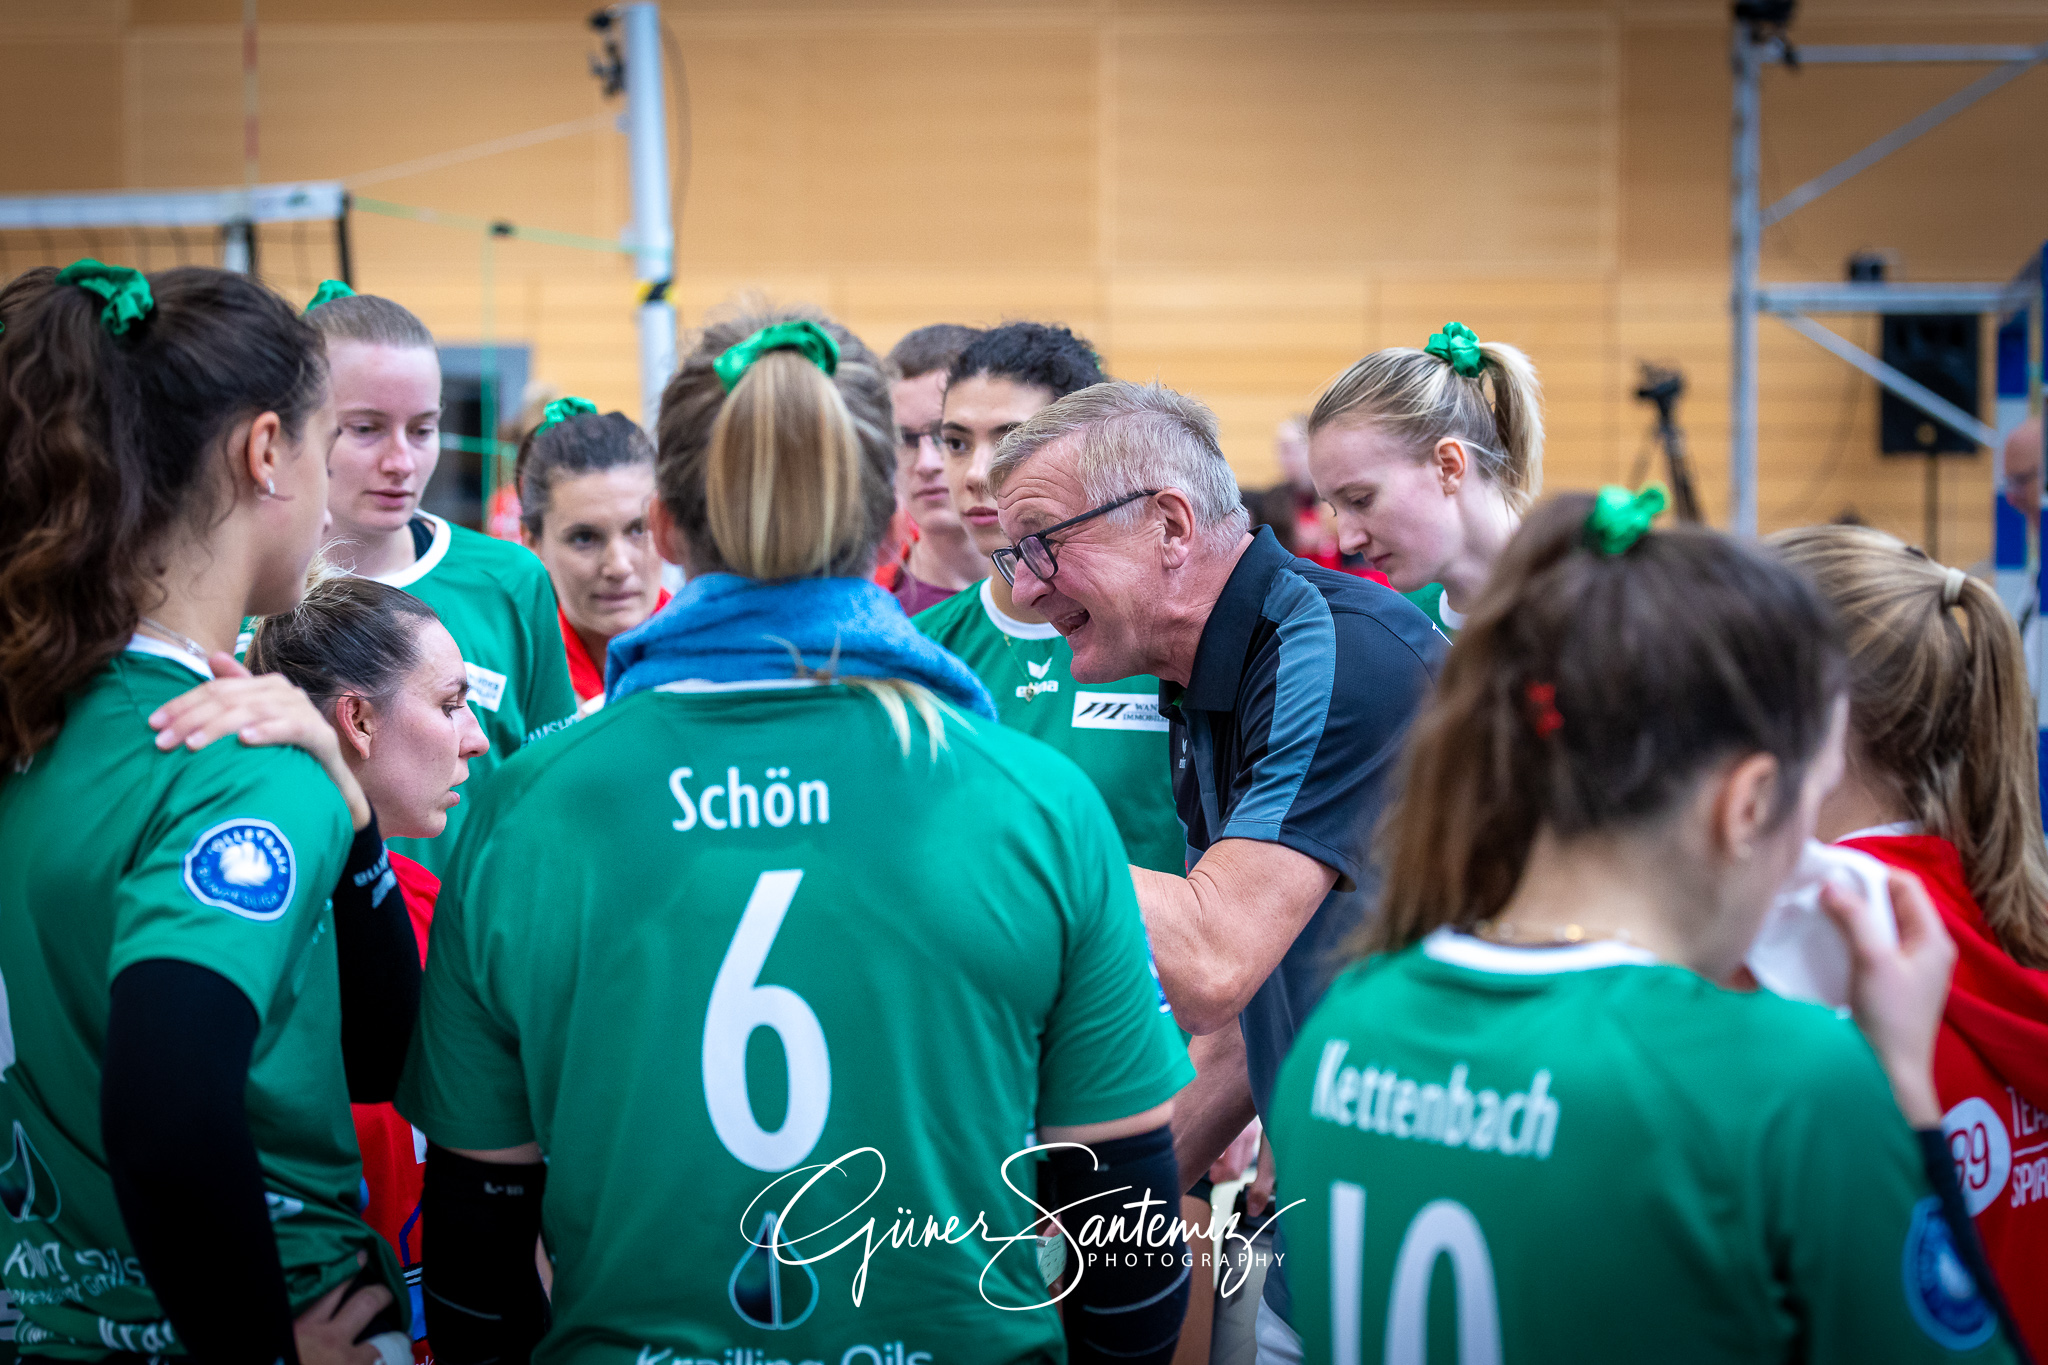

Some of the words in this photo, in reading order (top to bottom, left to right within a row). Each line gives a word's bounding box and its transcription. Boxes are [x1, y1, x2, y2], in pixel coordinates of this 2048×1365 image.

[669, 766, 830, 831] Schön
[702, 868, 832, 1173] 6
[1310, 1038, 1561, 1161] Kettenbach
